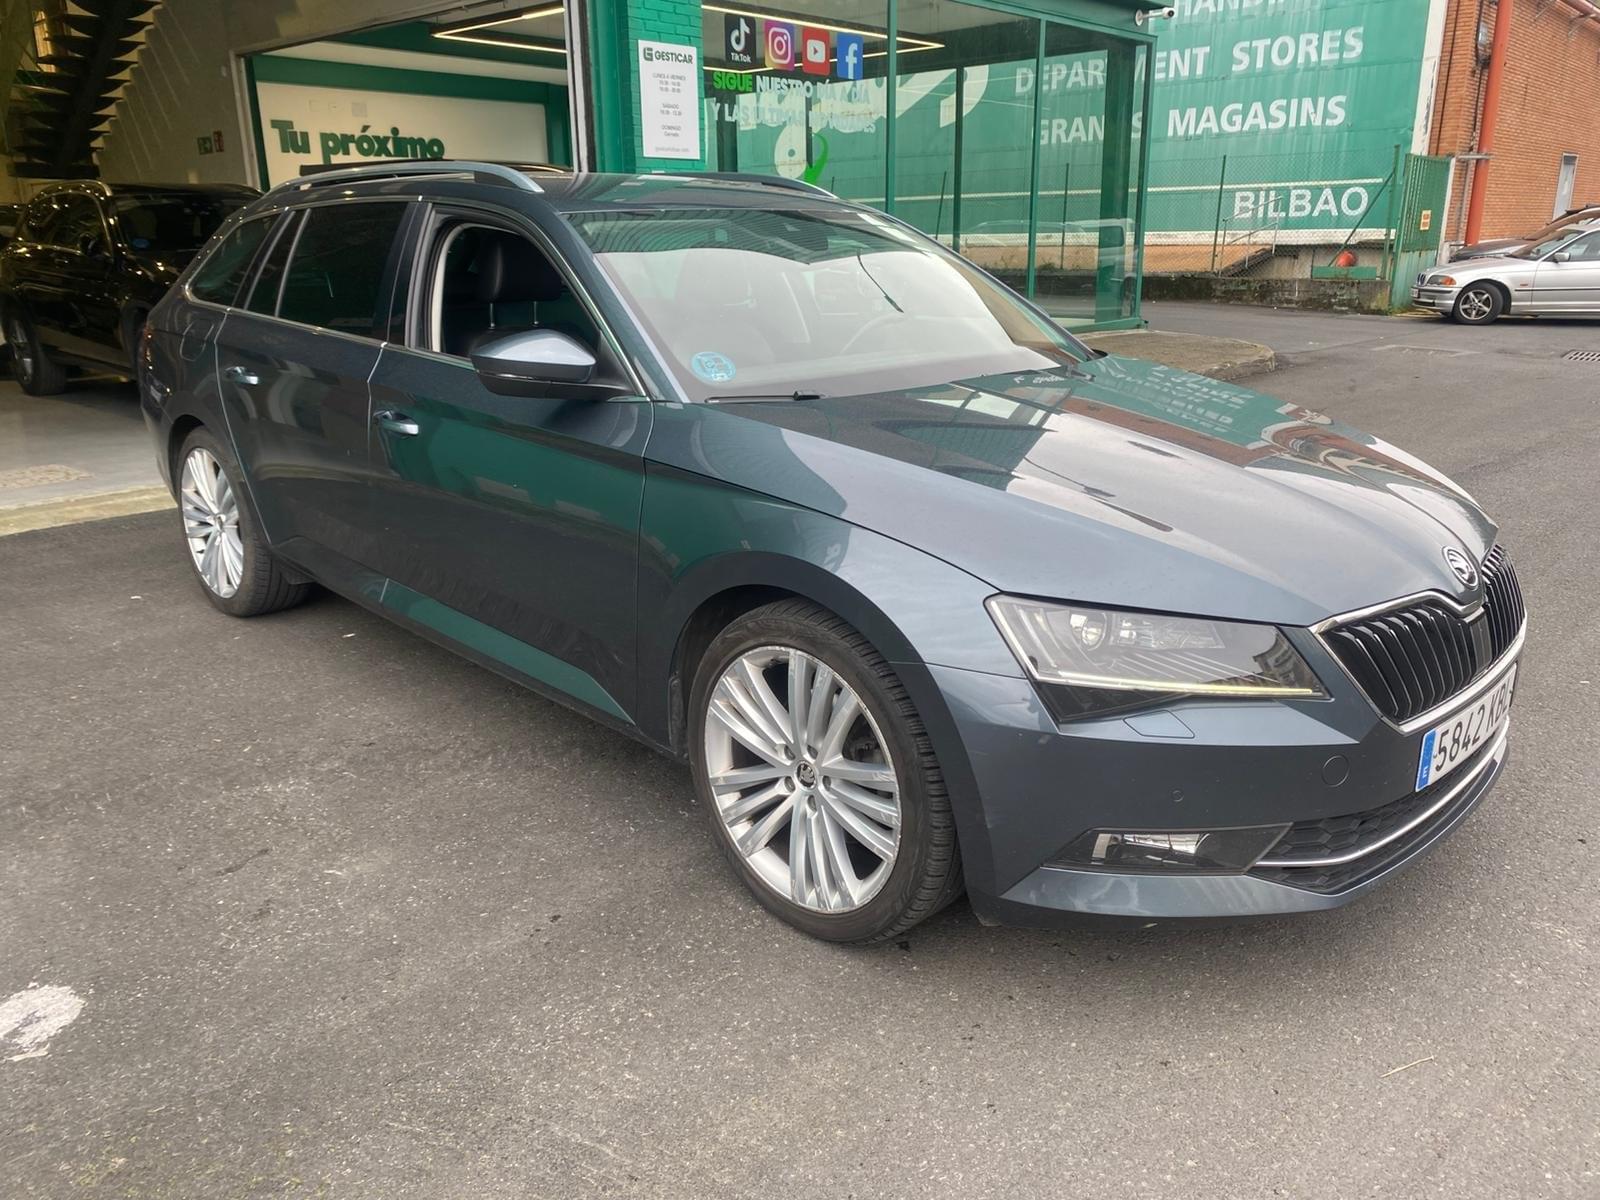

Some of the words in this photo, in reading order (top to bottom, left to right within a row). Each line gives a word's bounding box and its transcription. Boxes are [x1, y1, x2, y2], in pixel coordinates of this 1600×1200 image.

[654, 50, 693, 64] GESTICAR
[730, 52, 752, 63] TikTok
[1231, 26, 1364, 72] STORES
[712, 71, 752, 92] SIGUE
[756, 75, 813, 99] NUESTRO
[710, 102, 720, 121] Y
[724, 104, 750, 124] LAS
[1167, 95, 1347, 137] MAGASINS
[270, 120, 311, 154] Tu
[320, 125, 445, 165] próximo
[1233, 186, 1369, 219] BILBAO
[1435, 704, 1485, 772] 5842
